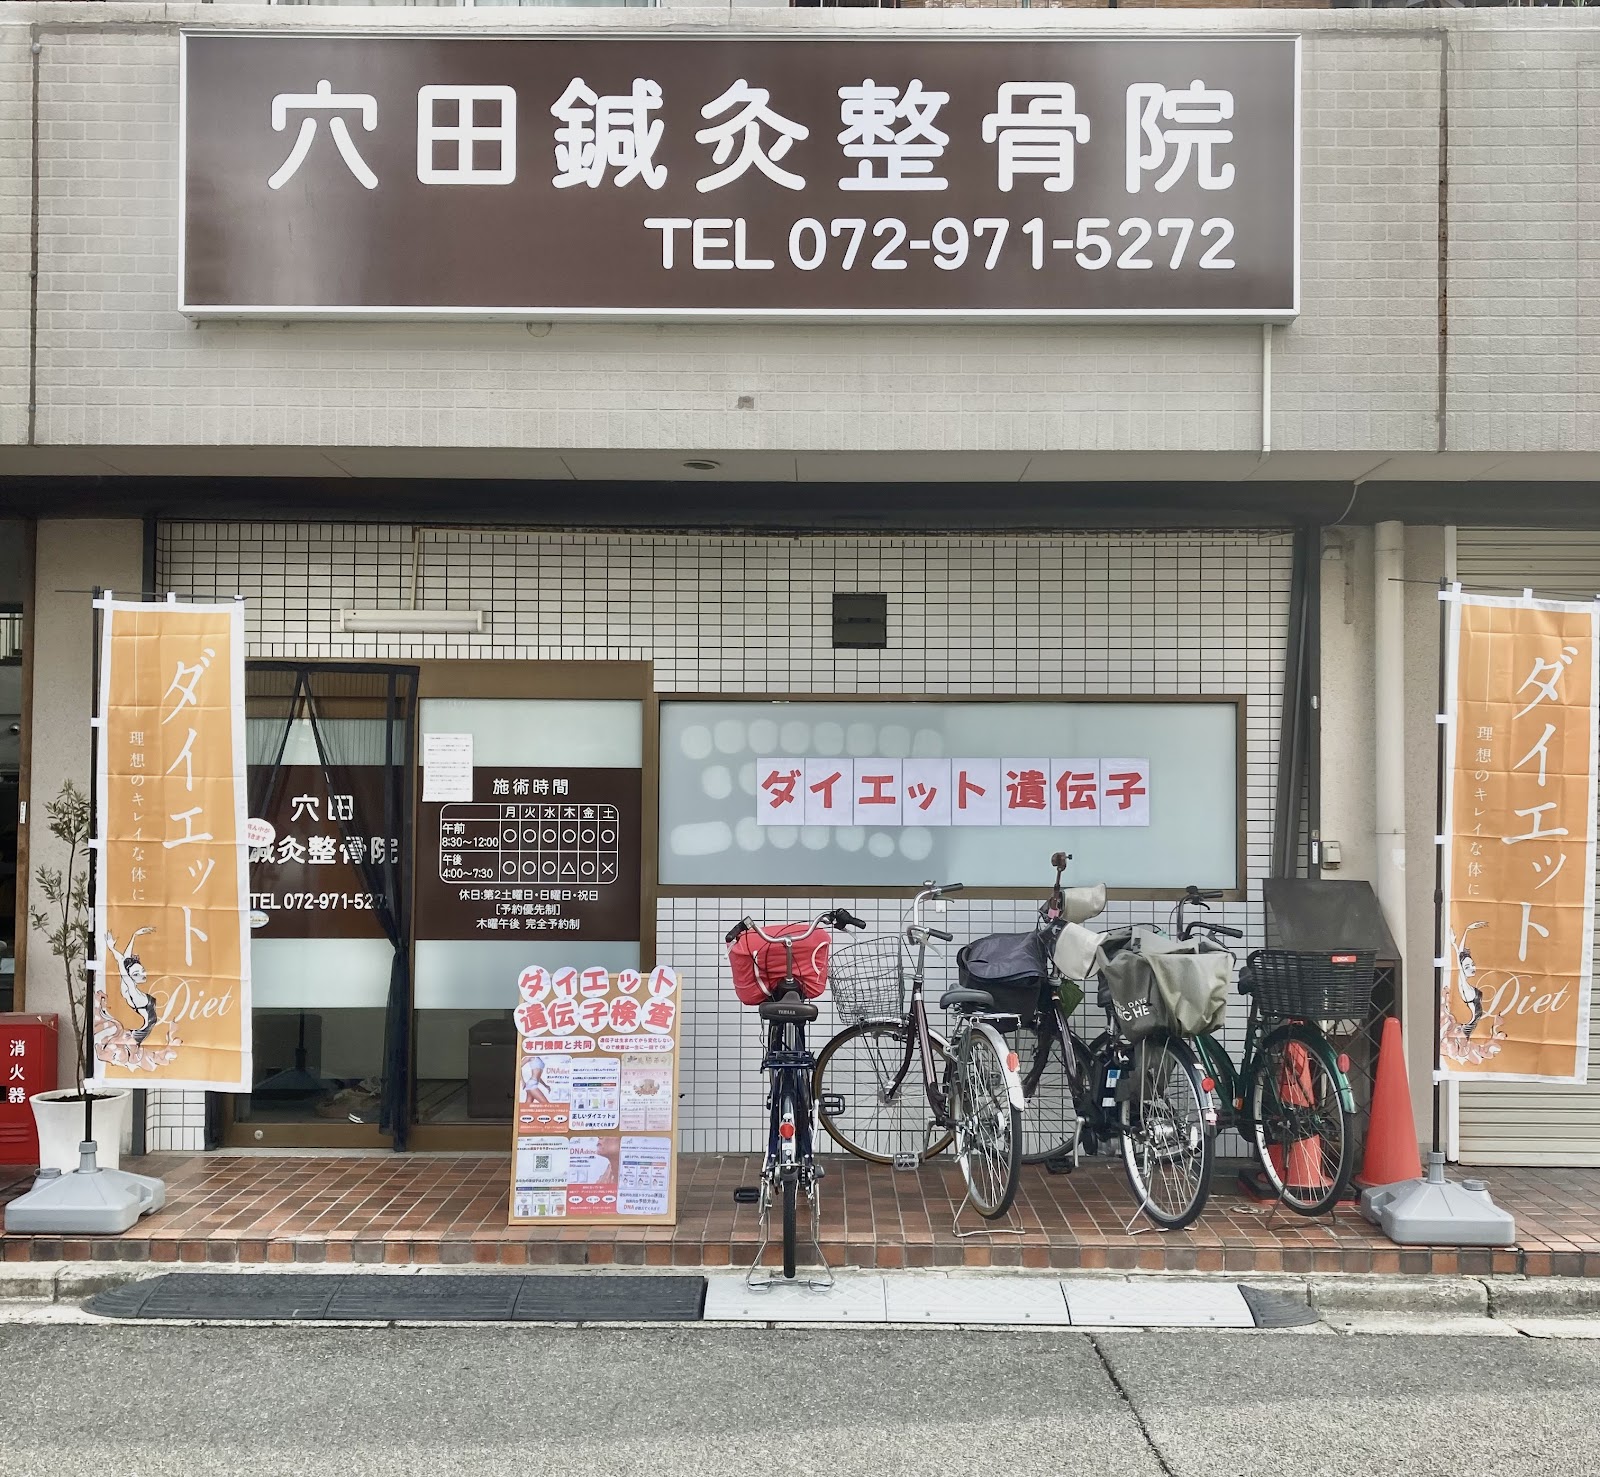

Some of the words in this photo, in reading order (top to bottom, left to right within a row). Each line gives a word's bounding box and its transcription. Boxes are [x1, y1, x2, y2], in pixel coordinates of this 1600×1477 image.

[267, 77, 1236, 193] 穴田鍼灸整骨院
[643, 217, 775, 270] TEL
[788, 217, 1236, 271] 072-971-5272
[492, 778, 570, 796] 施術時間
[1501, 646, 1579, 962] ダイエット
[129, 731, 147, 901] 理想のキレイな体に
[161, 647, 216, 967] ダイエット
[290, 793, 354, 822] 穴田
[504, 806, 517, 819] 月
[524, 806, 537, 819] 火
[543, 806, 556, 819] 水
[563, 806, 576, 819] 木
[582, 806, 595, 819] 金
[602, 807, 615, 819] 土
[1468, 726, 1493, 896] 理想のキレイな体に
[442, 822, 466, 835] 午前
[442, 854, 463, 867] 午後
[250, 892, 281, 910] TEL
[476, 919, 521, 930] 木曜午後
[525, 919, 580, 930] 完全予約制
[520, 968, 674, 998] ダイエット
[1475, 970, 1571, 1020] Diet
[148, 975, 235, 1026] Diet
[517, 999, 675, 1033] 遺伝子検査
[1128, 997, 1148, 1008] DAYS
[8, 1039, 26, 1104] 消火器
